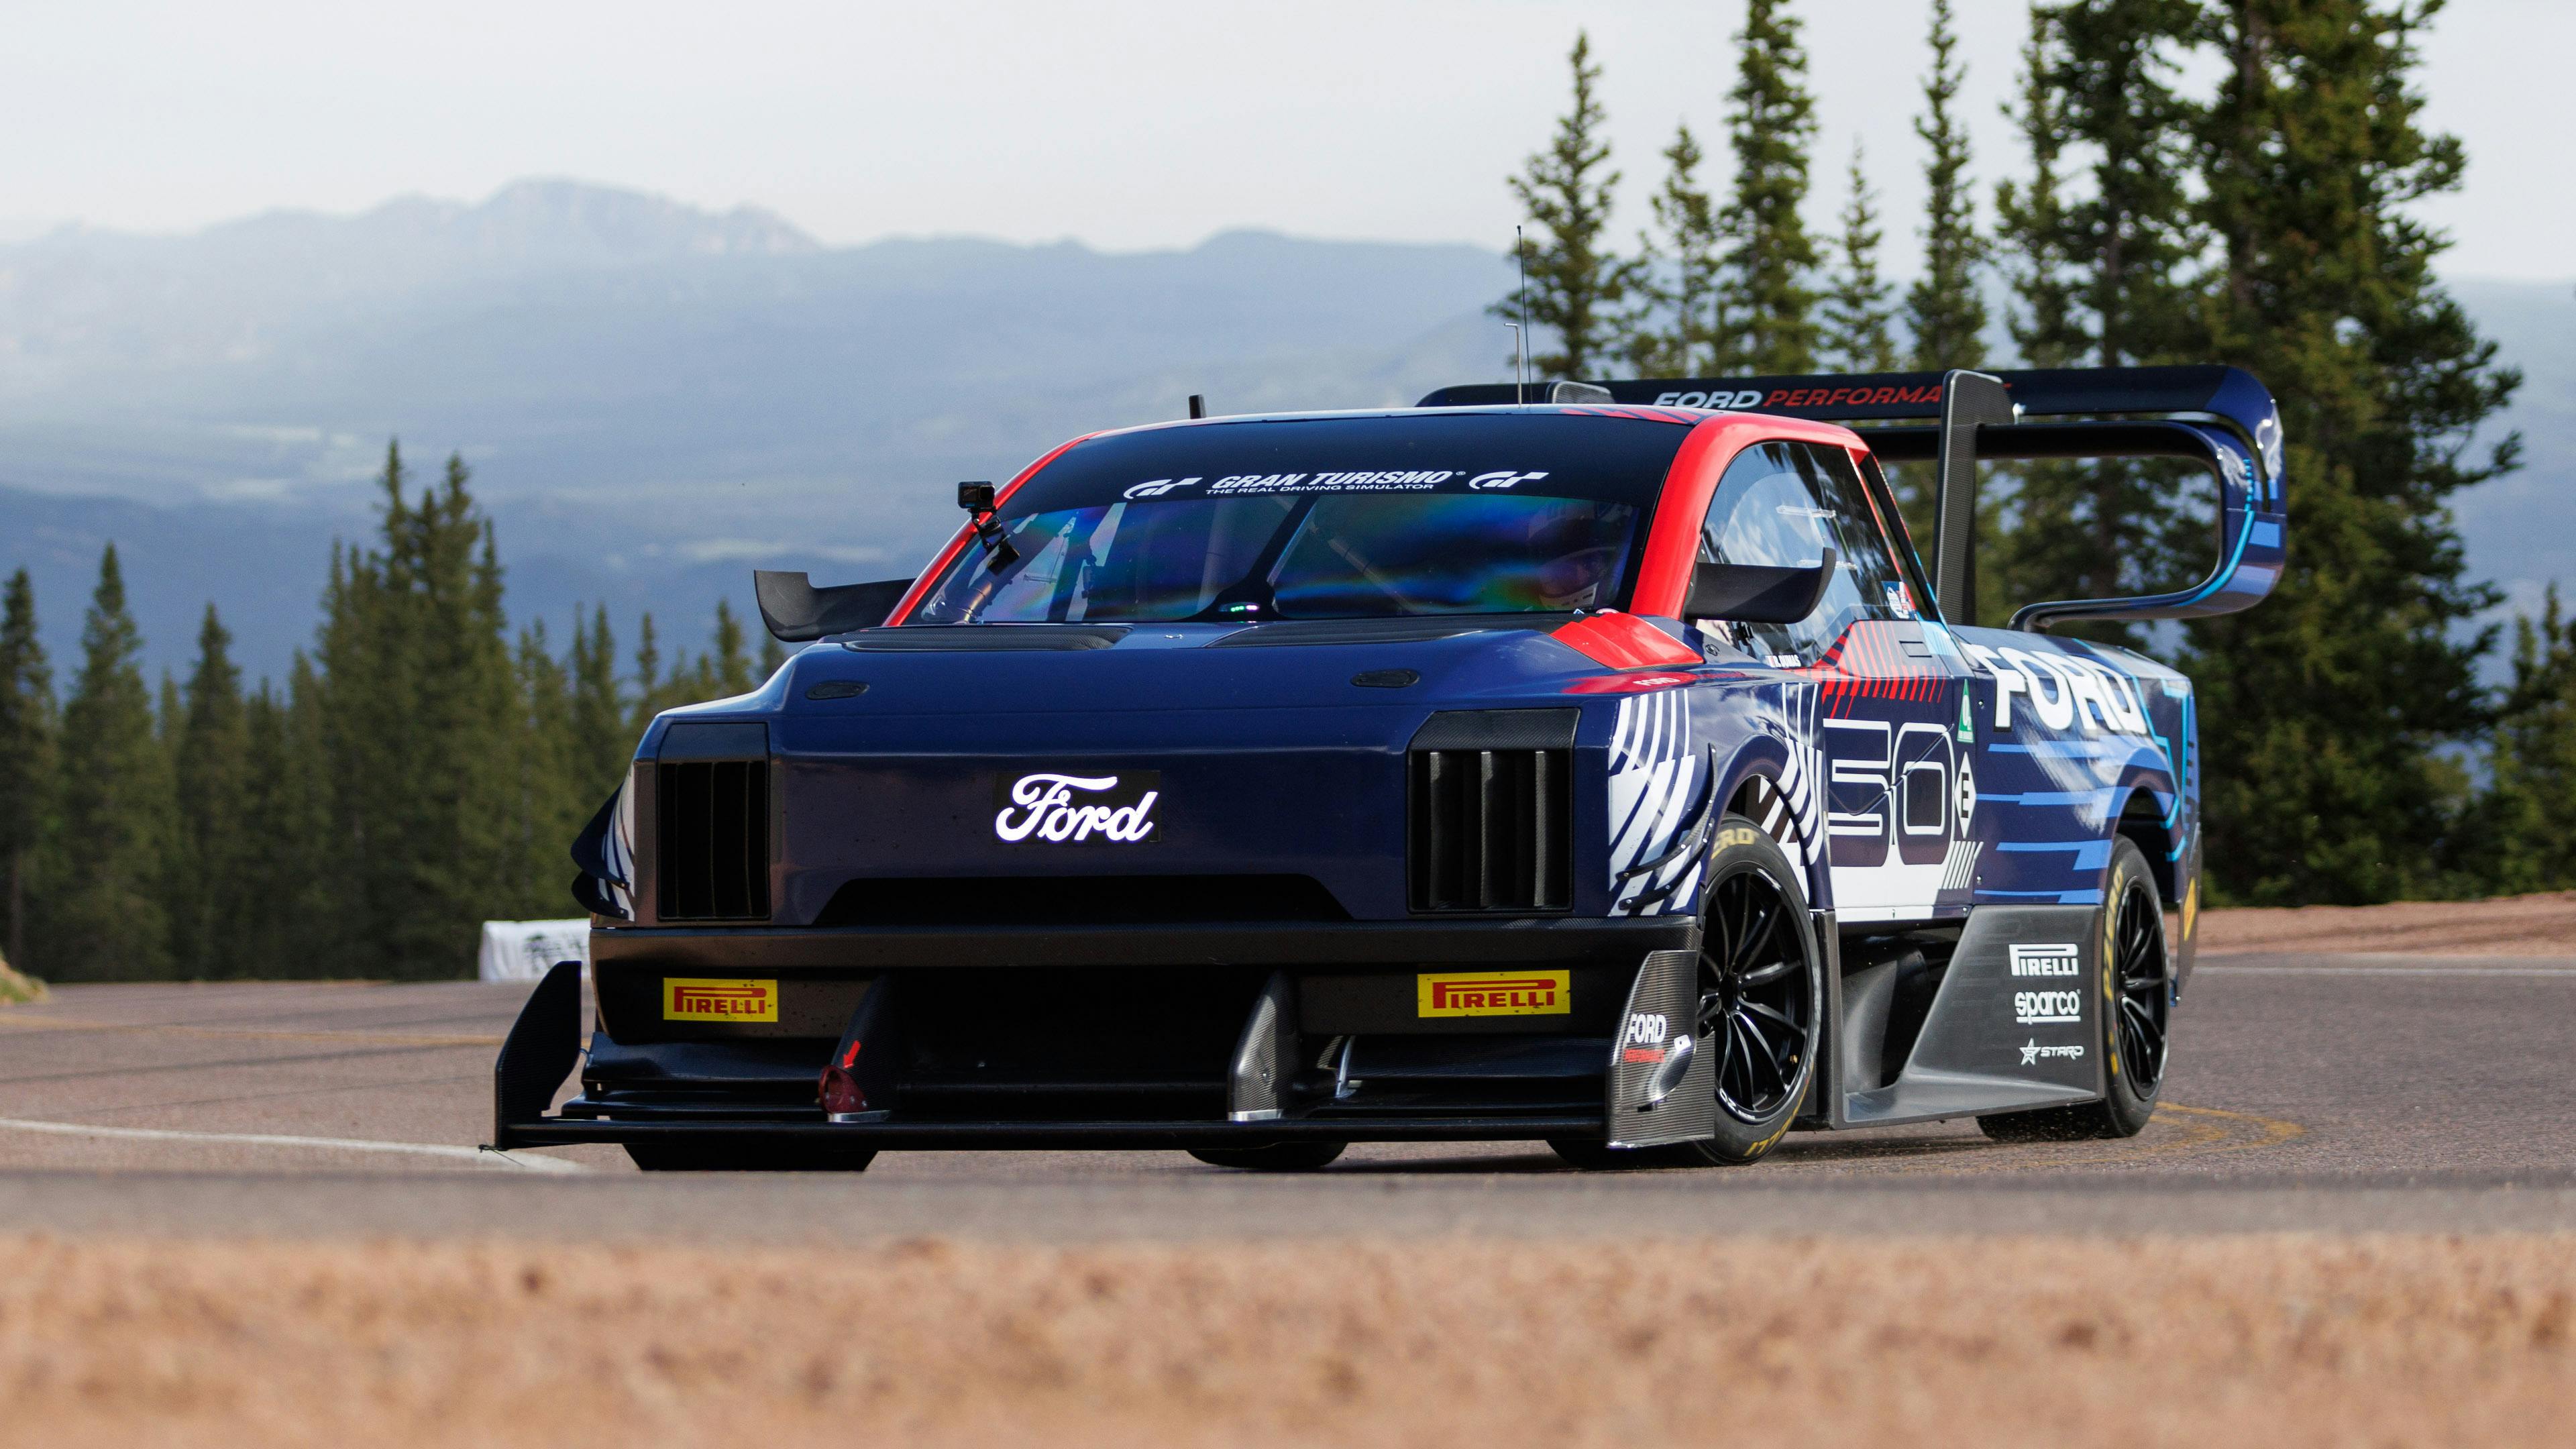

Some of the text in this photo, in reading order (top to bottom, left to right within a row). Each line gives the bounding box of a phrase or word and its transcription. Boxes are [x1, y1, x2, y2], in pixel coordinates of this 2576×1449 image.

[1654, 383, 2011, 409] FORD PERFORMA
[1212, 473, 1307, 489] GRAN
[1345, 483, 1434, 491] SIMULATOR
[1960, 642, 2147, 734] FORD
[996, 773, 1159, 841] Ford
[1823, 718, 1955, 867] 50
[2008, 944, 2079, 976] PIRELLI
[674, 986, 767, 1014] PIRELLI
[1433, 979, 1556, 1009] PIRELLI
[1626, 1014, 1667, 1043] FORD
